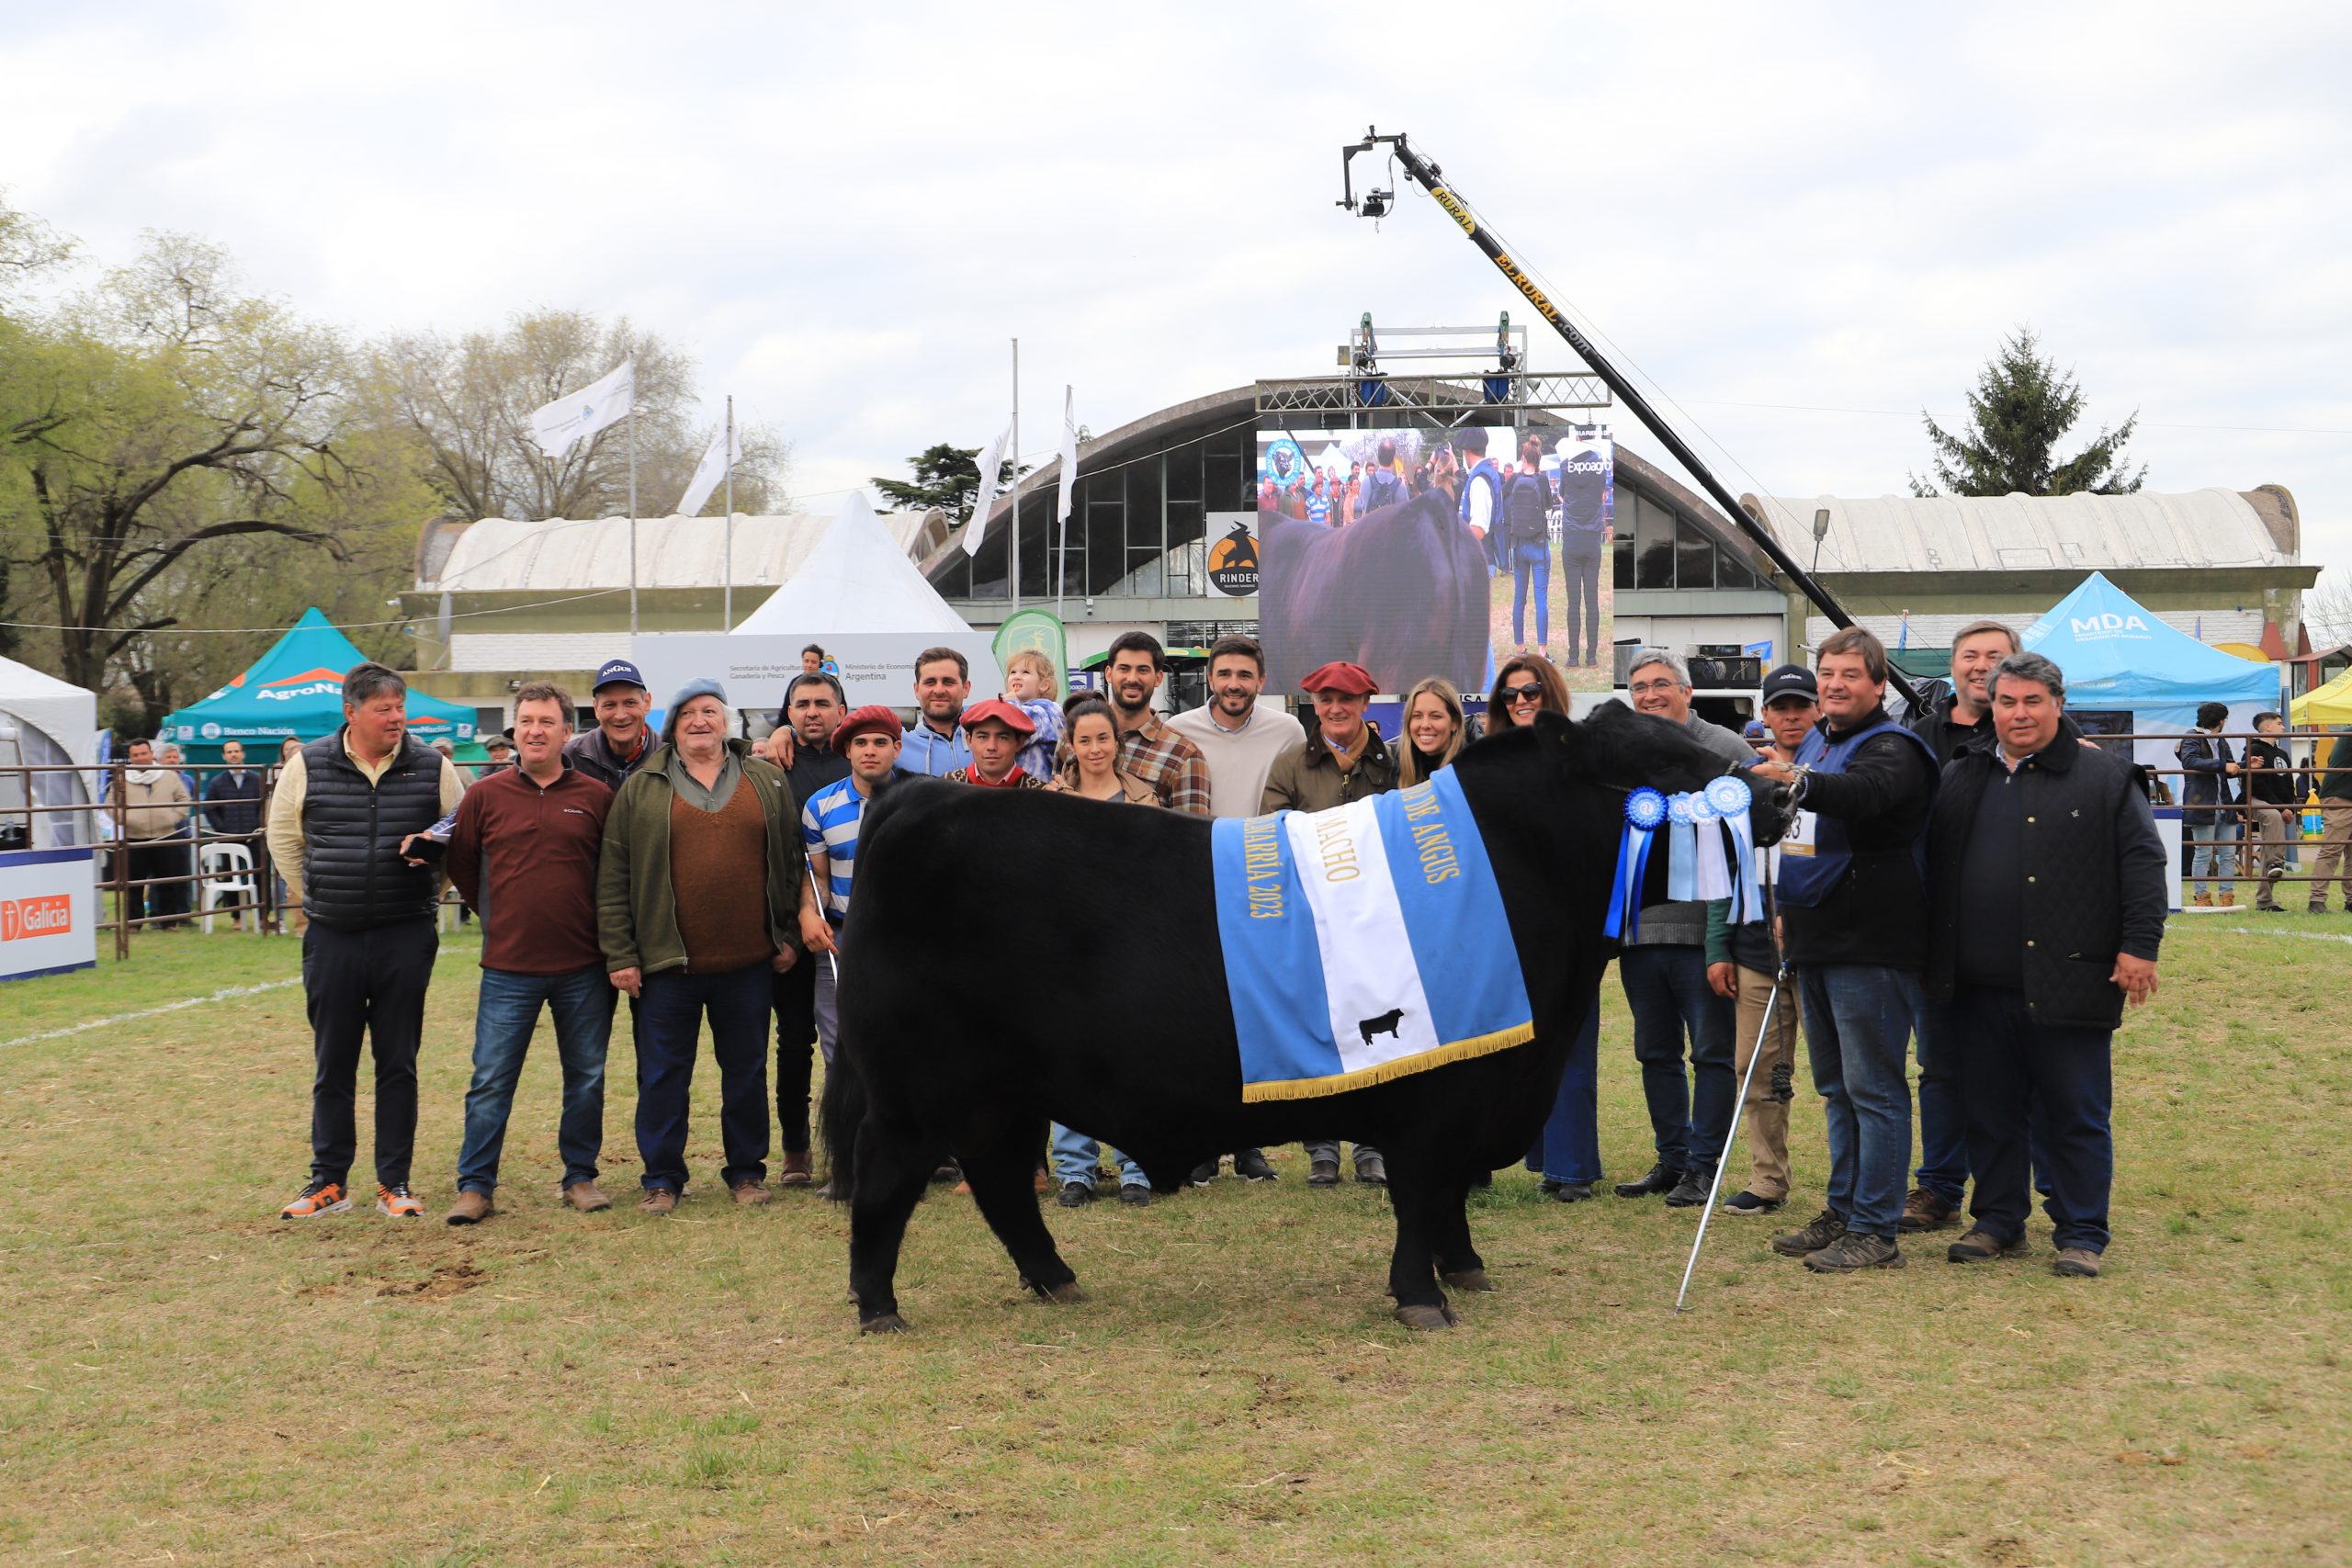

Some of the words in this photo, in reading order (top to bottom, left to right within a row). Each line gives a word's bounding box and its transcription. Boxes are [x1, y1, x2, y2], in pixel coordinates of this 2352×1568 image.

[1435, 191, 1473, 230] RURAL
[1567, 462, 1611, 475] Expoagro
[2070, 614, 2149, 634] MDA
[602, 665, 632, 677] ANGUS
[845, 672, 887, 682] Argentina
[223, 727, 256, 735] Banco
[257, 727, 295, 735] Nación
[1404, 794, 1441, 822] DE
[1315, 819, 1361, 883] MACHO
[1411, 823, 1461, 885] ANGUS
[1248, 884, 1284, 919] 2023
[24, 901, 69, 931] Galicia
